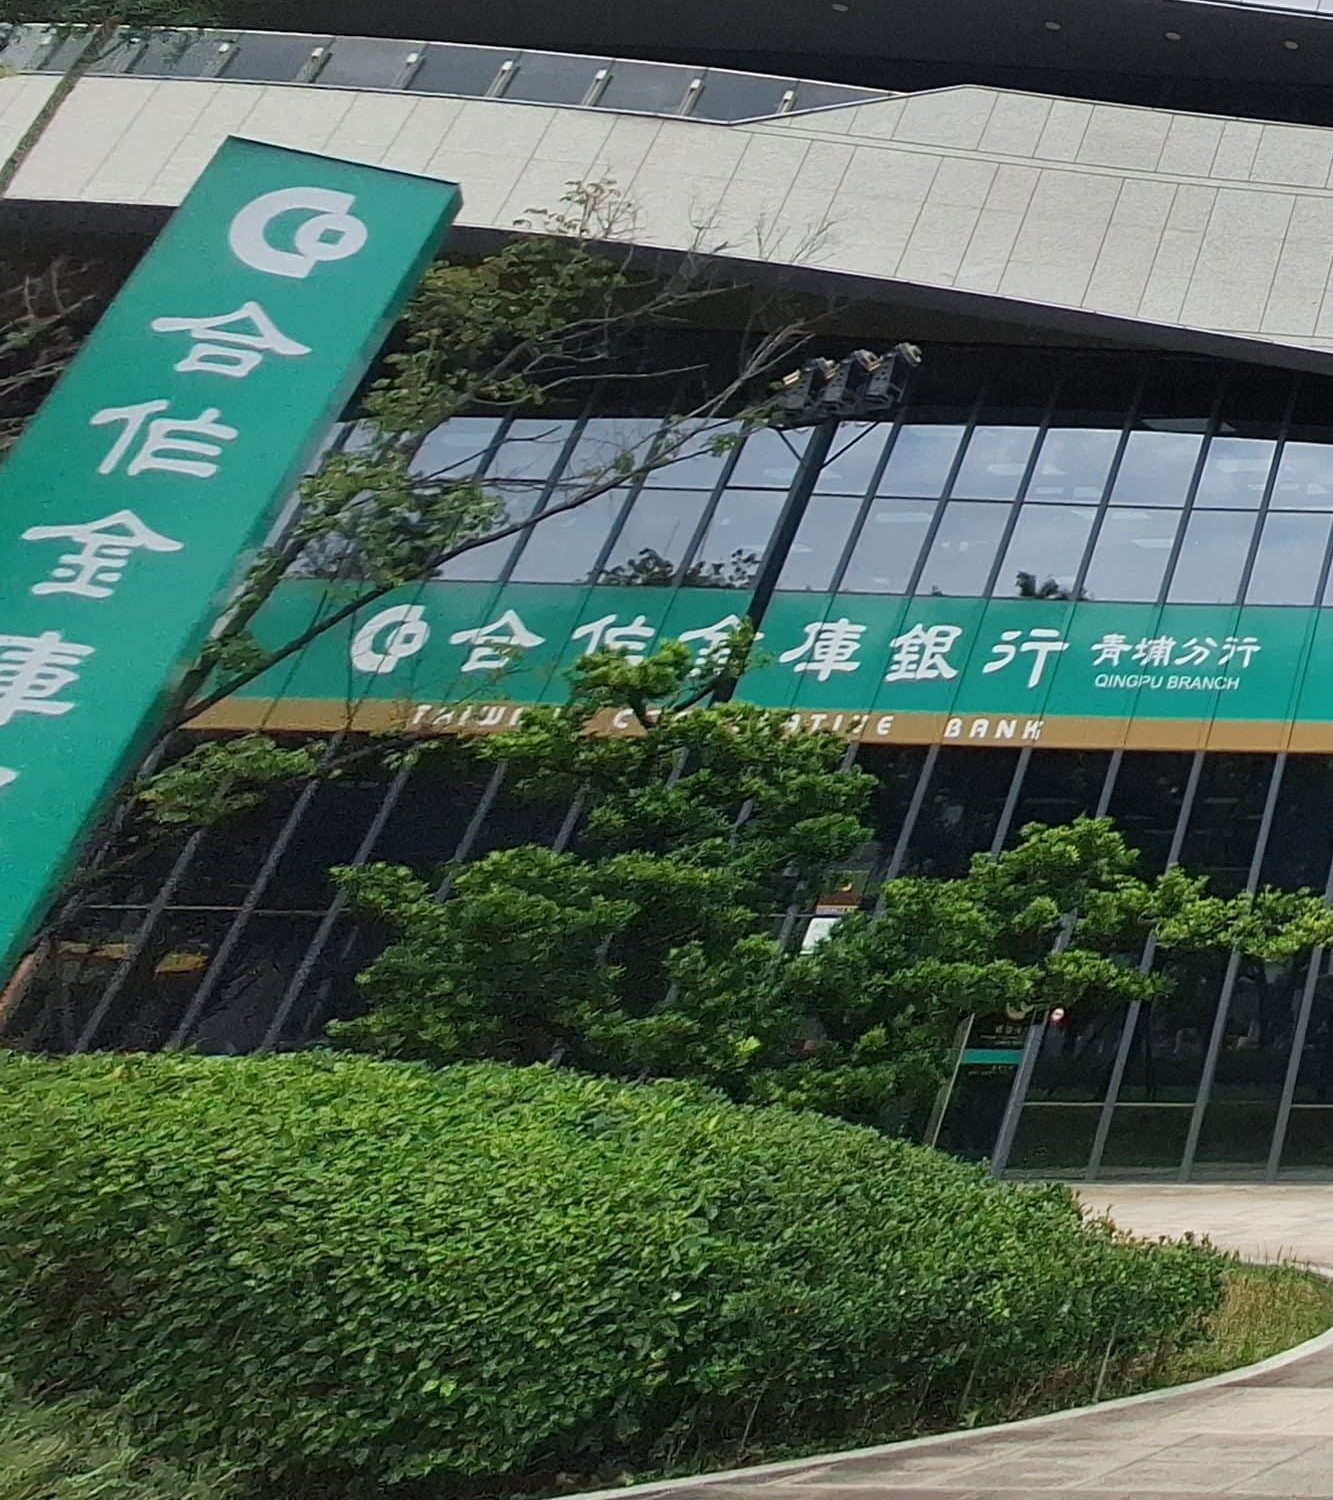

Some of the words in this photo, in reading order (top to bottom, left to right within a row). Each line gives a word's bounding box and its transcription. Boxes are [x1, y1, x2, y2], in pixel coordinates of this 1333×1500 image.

[0, 300, 312, 788] 合作金庫
[1090, 633, 1262, 668] 青埔分行
[1094, 673, 1164, 690] QINGPU
[1166, 674, 1241, 691] BRANCH
[944, 716, 1044, 741] BANK
